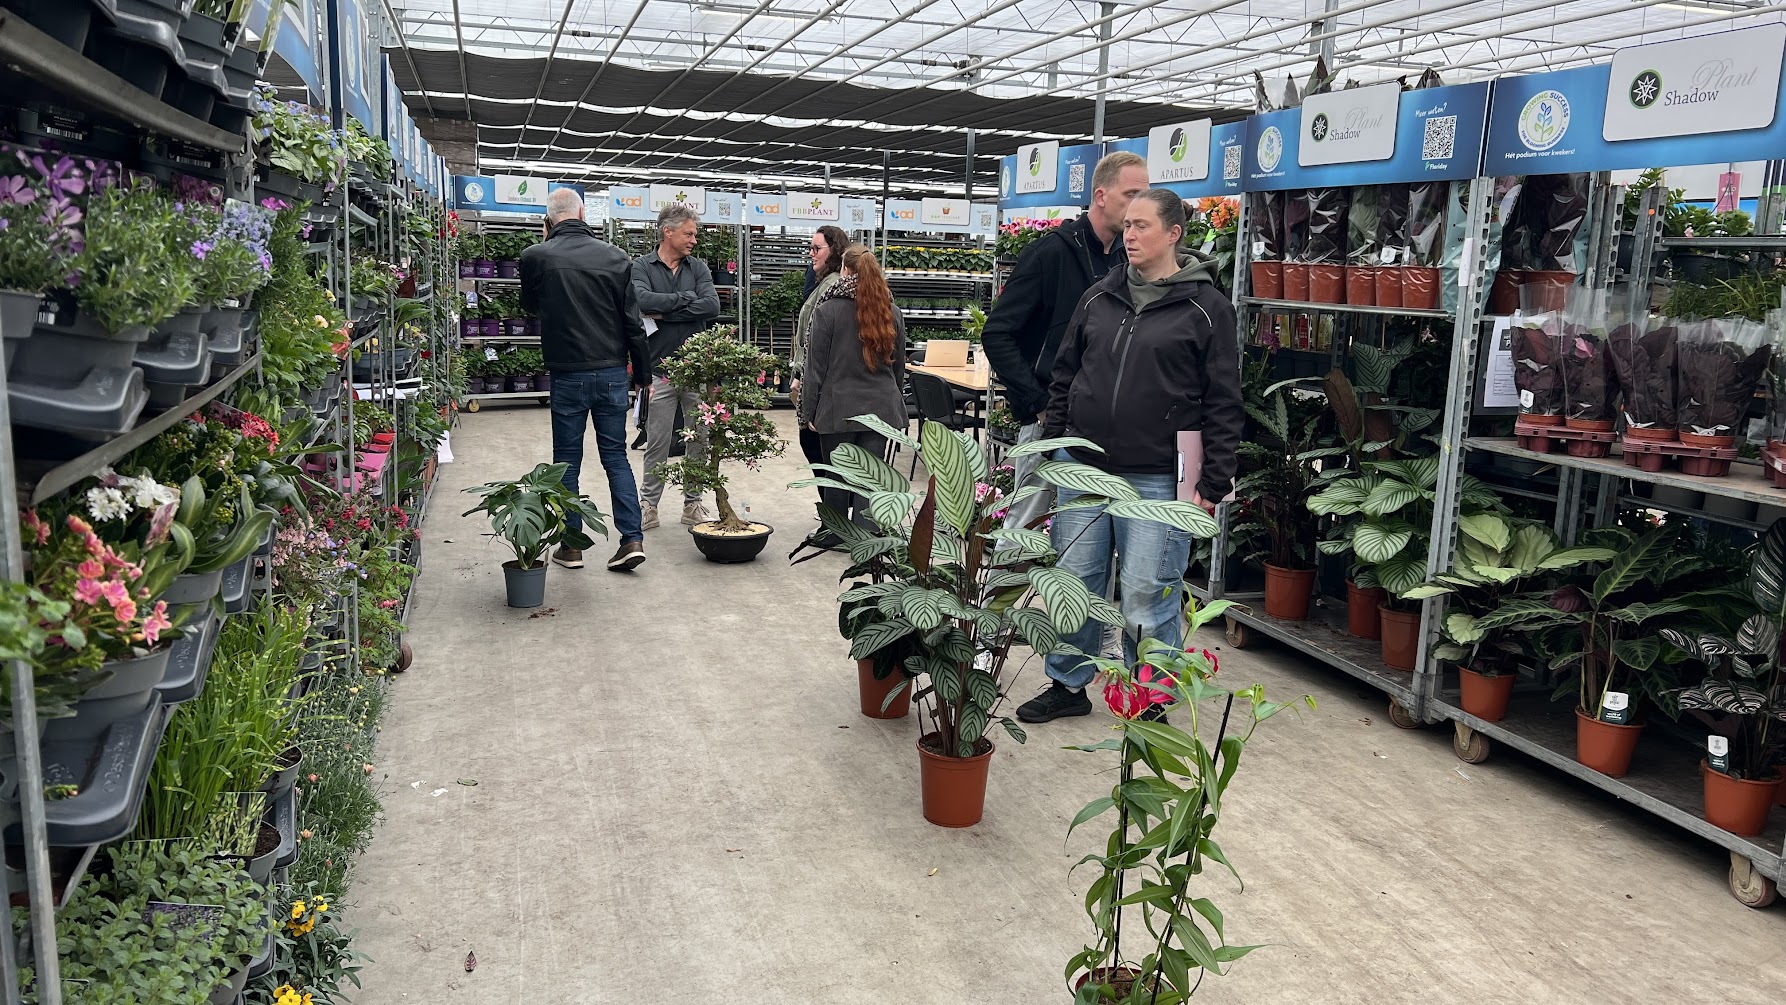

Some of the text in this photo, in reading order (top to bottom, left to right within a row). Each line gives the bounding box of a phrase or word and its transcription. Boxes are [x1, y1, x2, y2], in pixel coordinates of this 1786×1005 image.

[1690, 58, 1758, 90] Plant
[1664, 88, 1719, 106] Shadow
[1521, 92, 1569, 121] GROWING SUCCESS
[1344, 106, 1384, 130] Plant
[1329, 127, 1361, 141] Shadow
[1516, 150, 1537, 160] podium
[1551, 148, 1576, 156] kwekers!
[1160, 166, 1194, 180] APARTUS
[1429, 163, 1448, 171] Floriday
[1023, 180, 1046, 191] APARTUS
[792, 208, 834, 216] FBBPLANT
